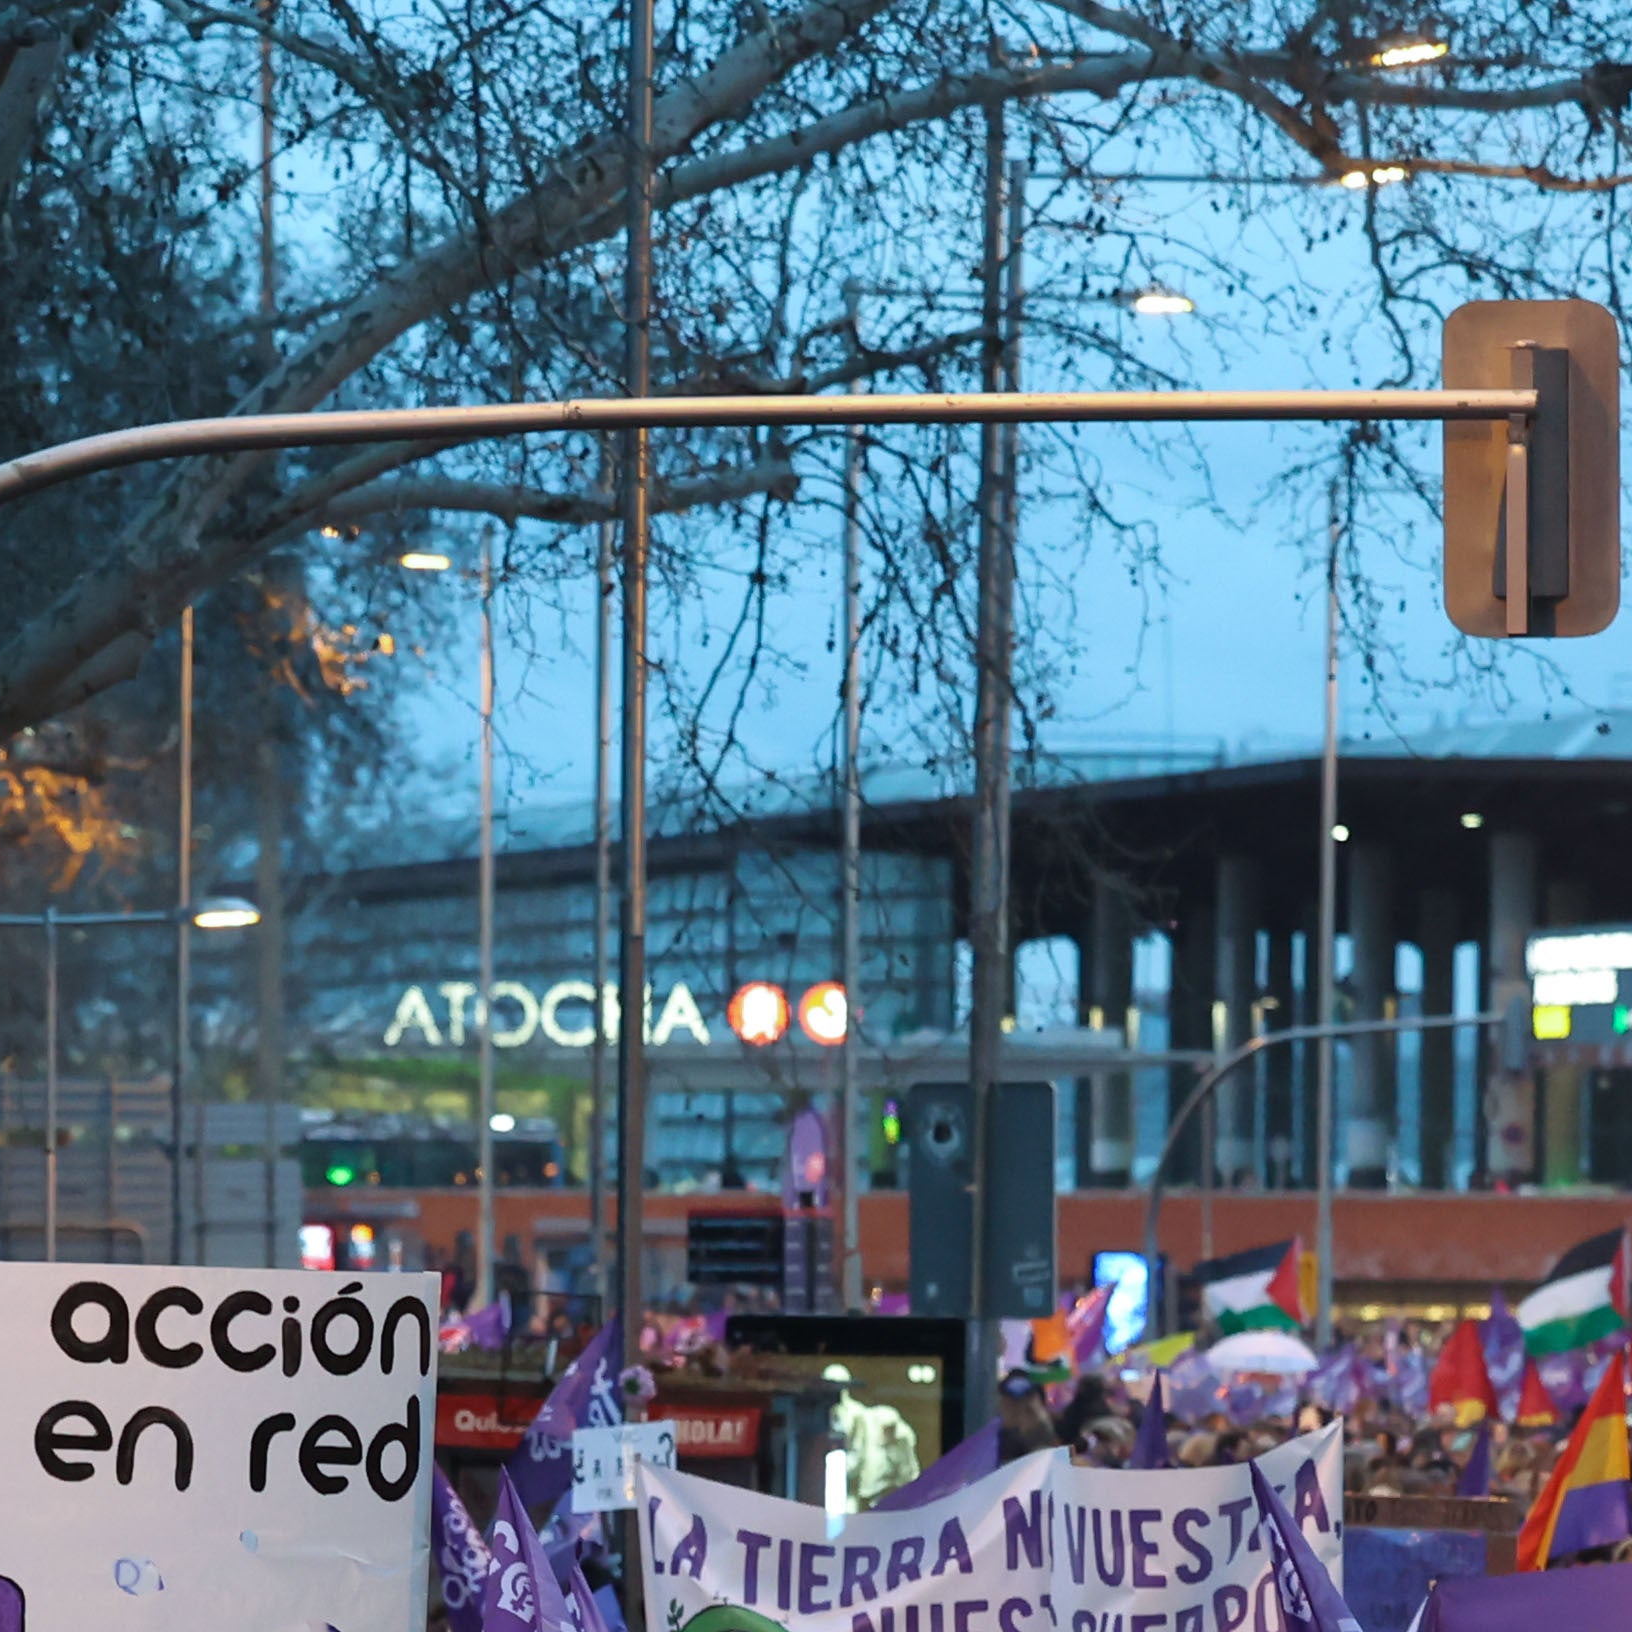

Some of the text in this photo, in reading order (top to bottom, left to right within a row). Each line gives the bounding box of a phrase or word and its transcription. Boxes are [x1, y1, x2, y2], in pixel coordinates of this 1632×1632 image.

[51, 1281, 431, 1377] acción
[35, 1400, 193, 1491] en
[250, 1396, 421, 1502] red
[648, 1496, 708, 1579] LA
[737, 1516, 973, 1616] TIERRA
